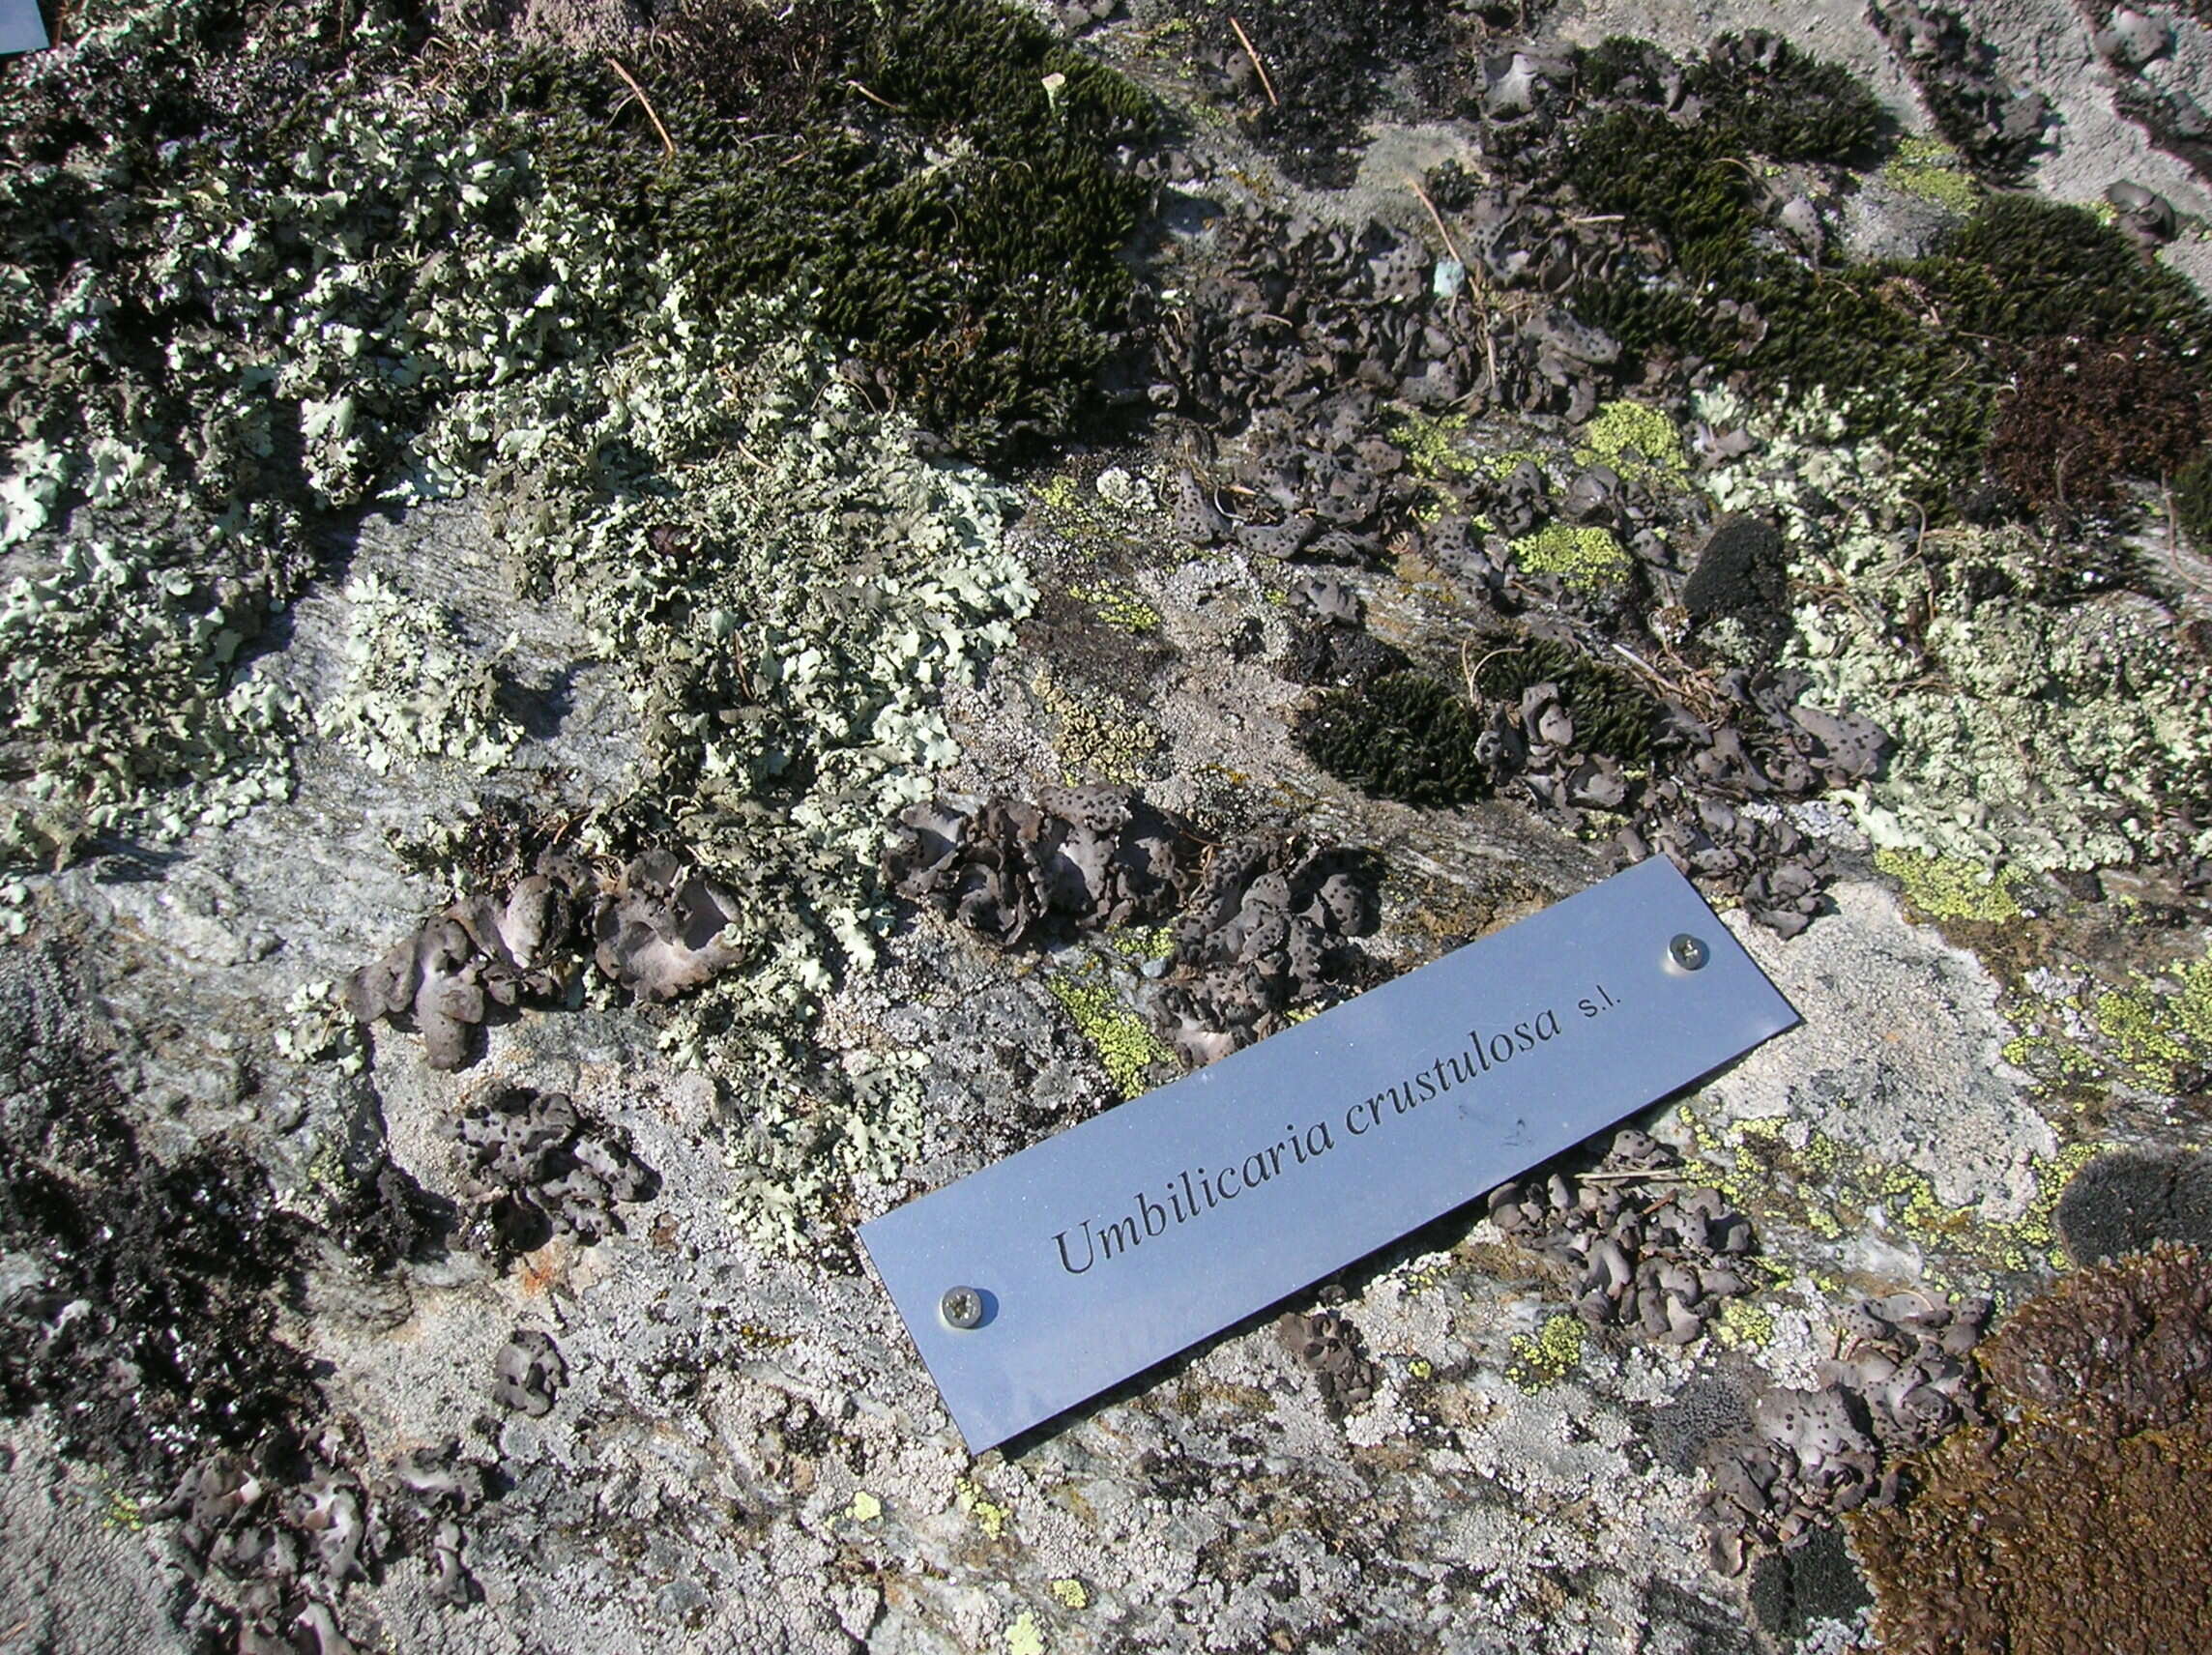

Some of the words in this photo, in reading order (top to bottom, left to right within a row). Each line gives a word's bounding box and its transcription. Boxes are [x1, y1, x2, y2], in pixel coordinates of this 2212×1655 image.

[1051, 1120, 1335, 1274] Umbilicaria
[1346, 1008, 1562, 1136] crustulosa
[1578, 984, 1621, 1018] s.l.
